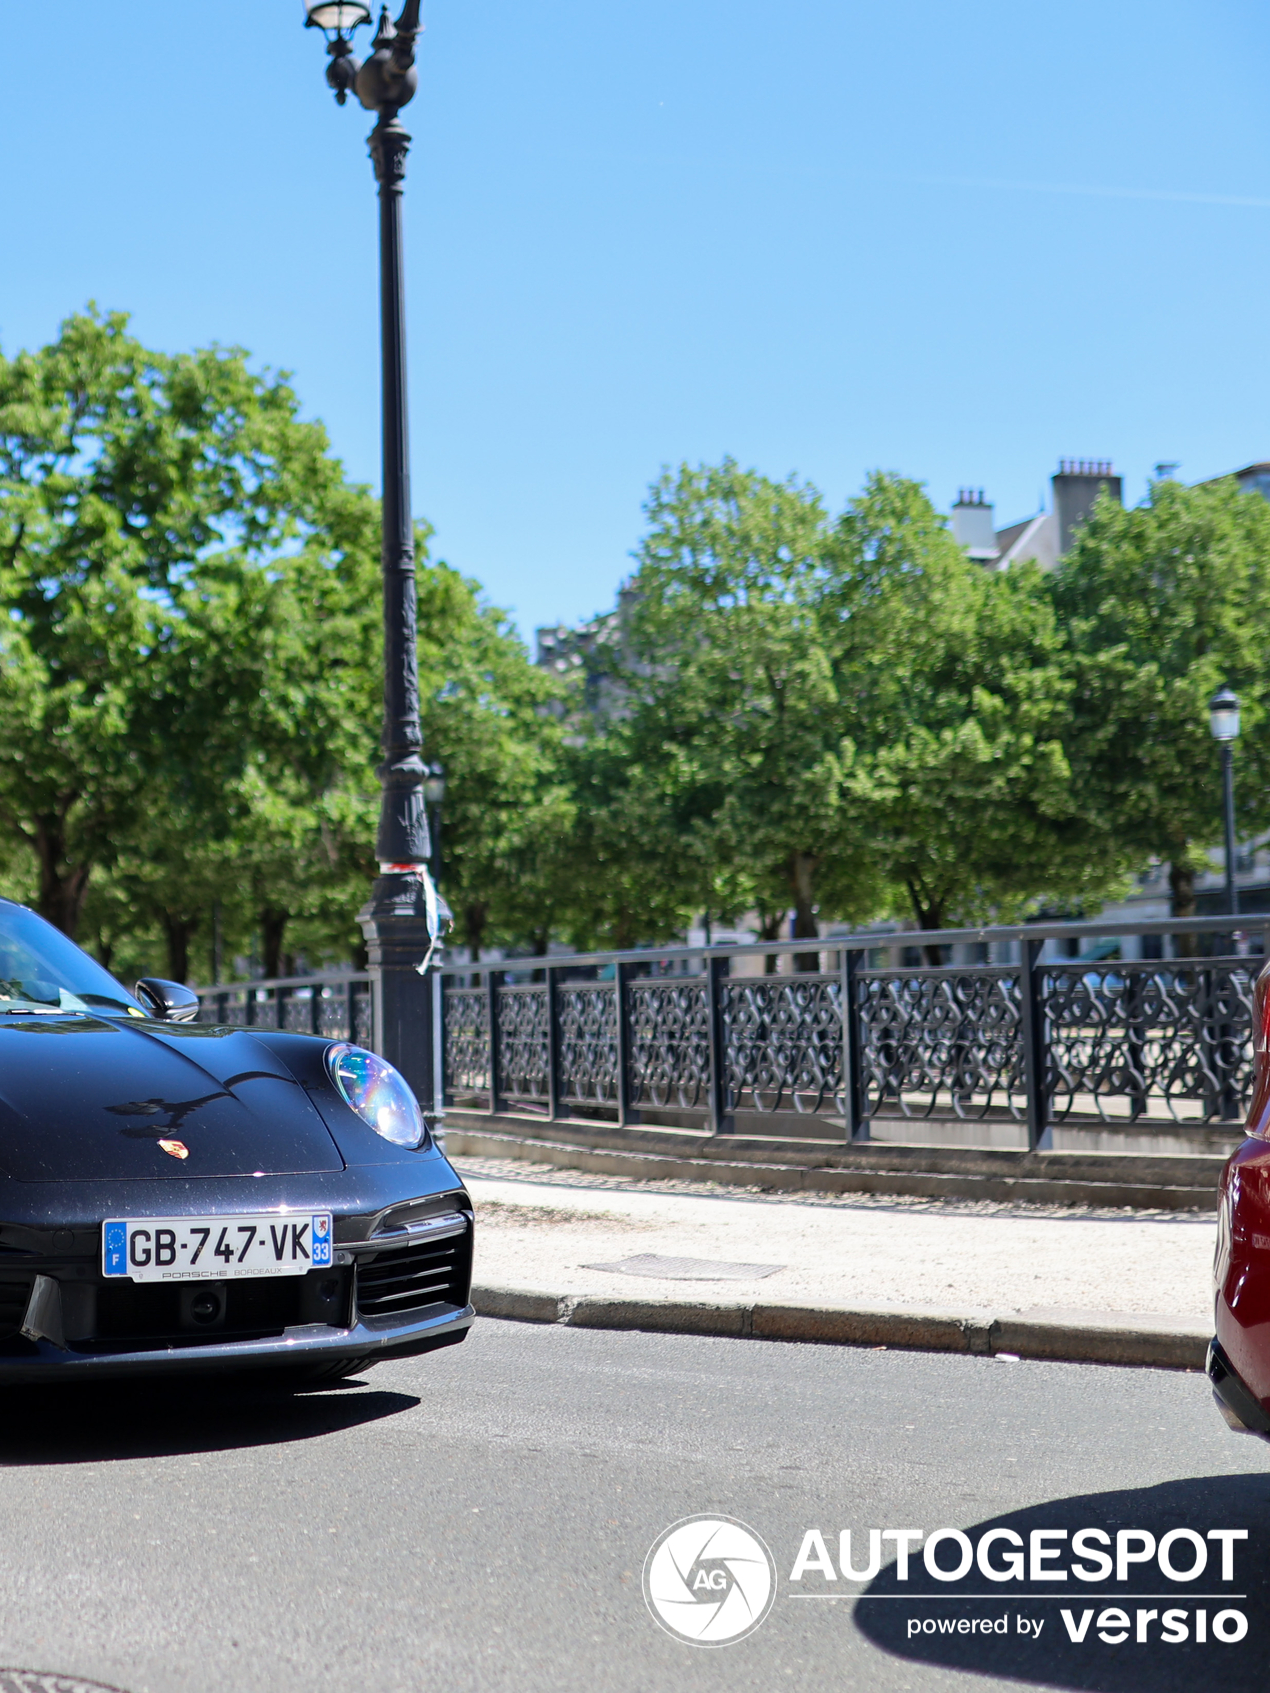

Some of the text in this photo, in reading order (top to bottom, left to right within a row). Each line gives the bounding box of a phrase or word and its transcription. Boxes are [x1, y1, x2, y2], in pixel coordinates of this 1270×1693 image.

[130, 1223, 310, 1266] GB-747-VK
[313, 1243, 329, 1260] 33
[112, 1254, 120, 1265] F
[162, 1267, 283, 1279] PORSCHE BORDEAUX
